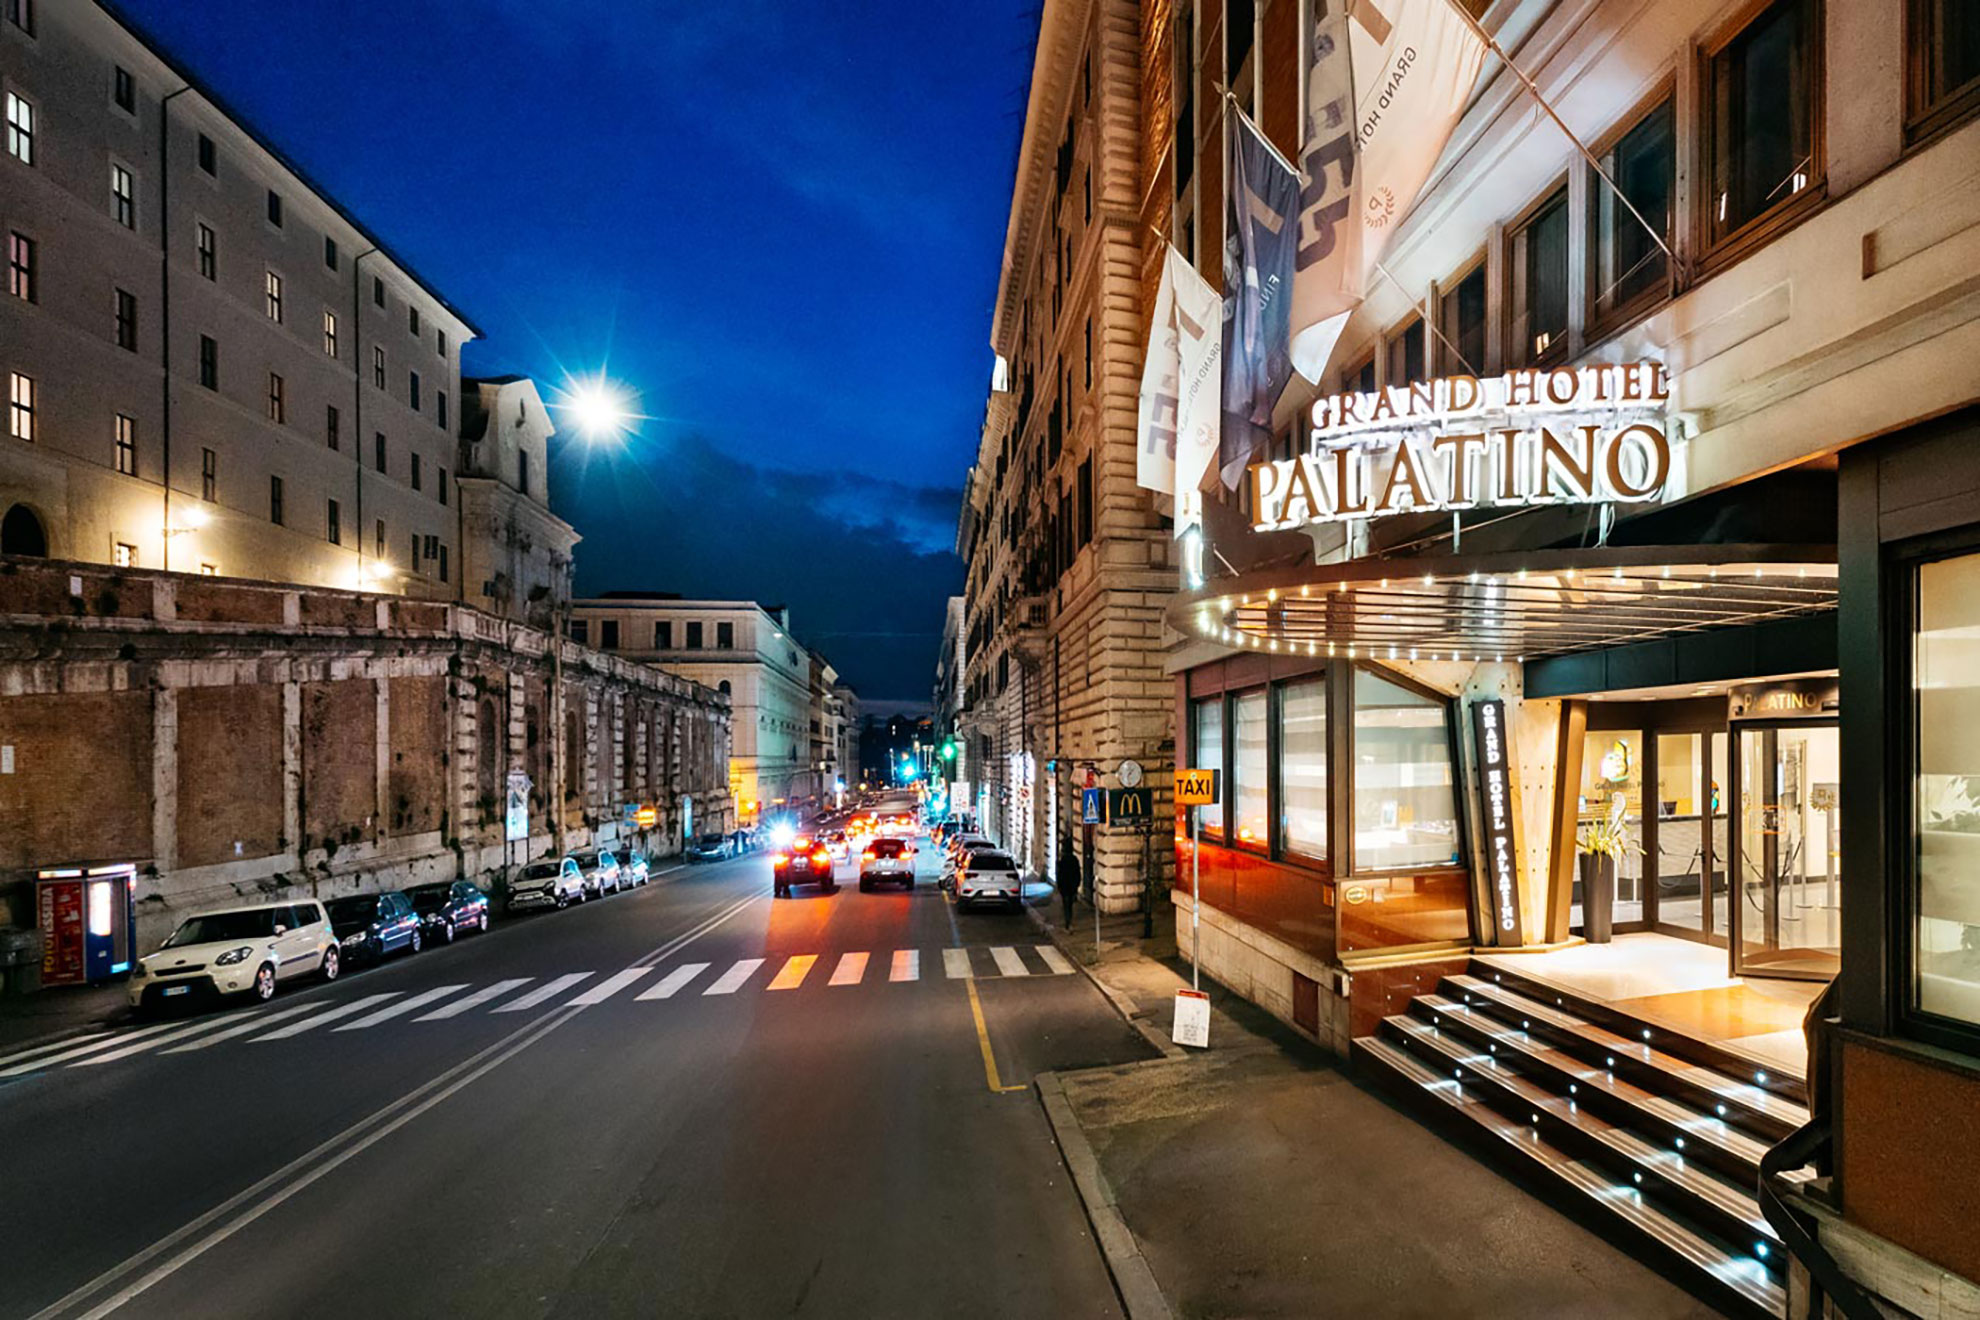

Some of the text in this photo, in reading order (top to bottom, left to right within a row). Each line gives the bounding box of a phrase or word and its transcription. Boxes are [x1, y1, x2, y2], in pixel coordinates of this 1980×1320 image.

[1312, 363, 1671, 429] GRAND HOTEL
[1246, 423, 1671, 528] PALATINO
[1176, 779, 1210, 796] TAXI
[1482, 704, 1515, 931] GRAND HOTEL PALATINO
